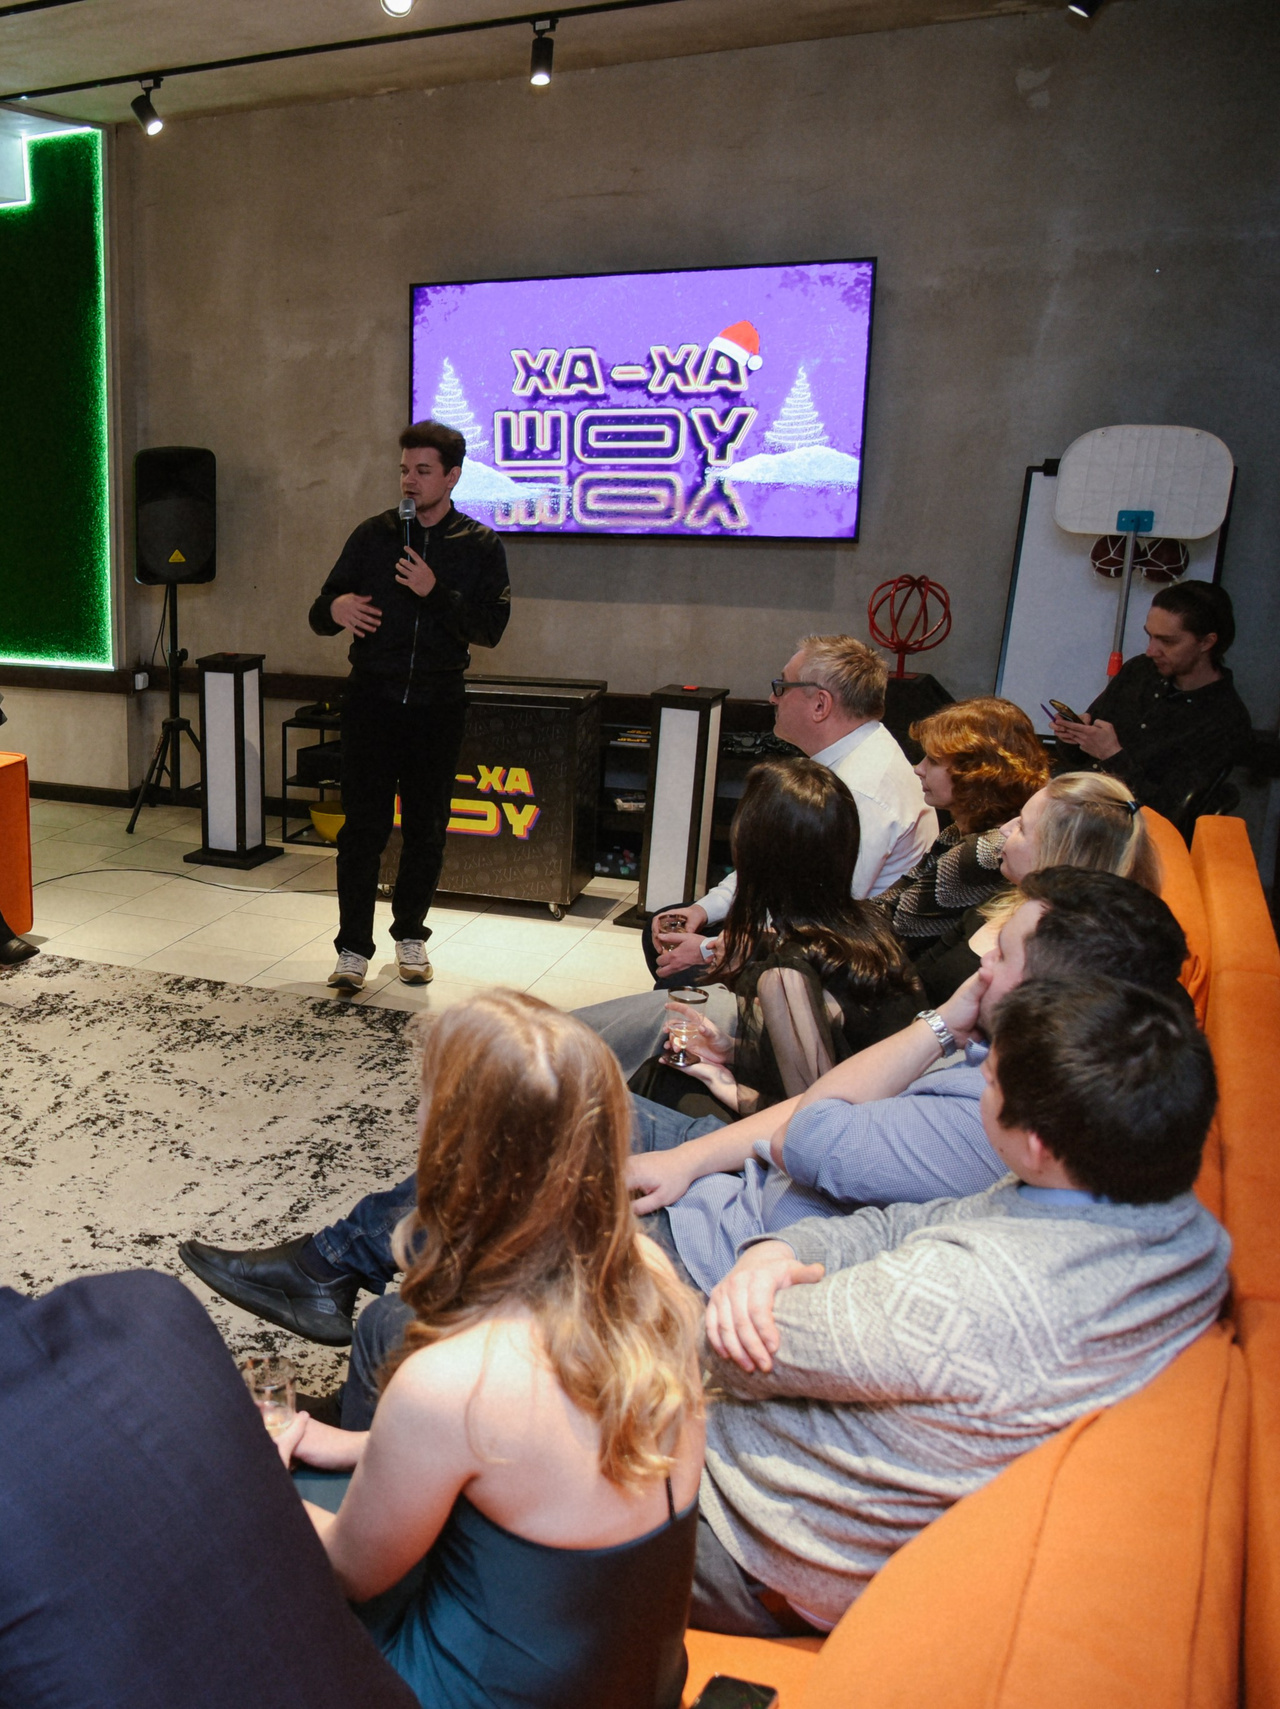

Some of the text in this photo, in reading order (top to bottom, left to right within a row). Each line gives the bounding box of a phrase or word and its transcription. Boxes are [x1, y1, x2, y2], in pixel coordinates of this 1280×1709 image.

[511, 344, 749, 396] ХА-ХА
[494, 407, 757, 466] ШОУ
[455, 765, 535, 797] -ХА
